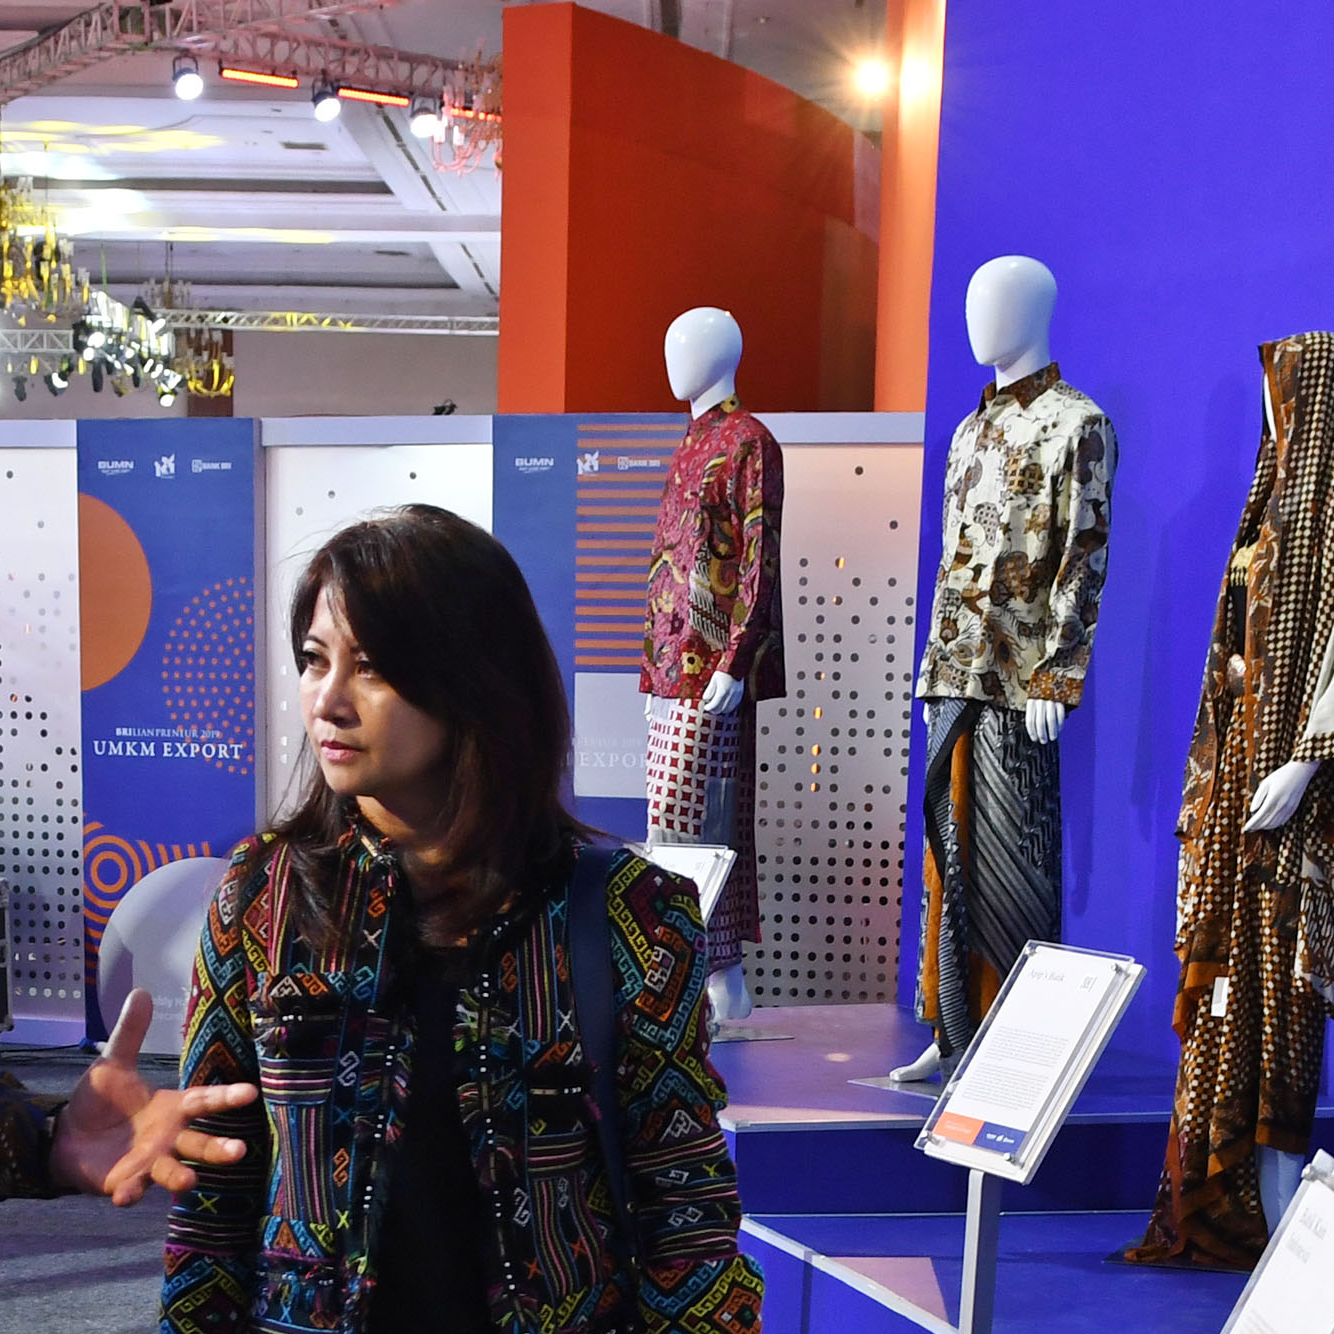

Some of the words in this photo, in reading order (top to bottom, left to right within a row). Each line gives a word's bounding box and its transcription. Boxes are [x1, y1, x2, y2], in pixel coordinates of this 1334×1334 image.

[97, 460, 134, 470] BUMN
[515, 457, 555, 467] BUMN
[93, 740, 156, 756] UMKM
[162, 742, 243, 759] EXPORT
